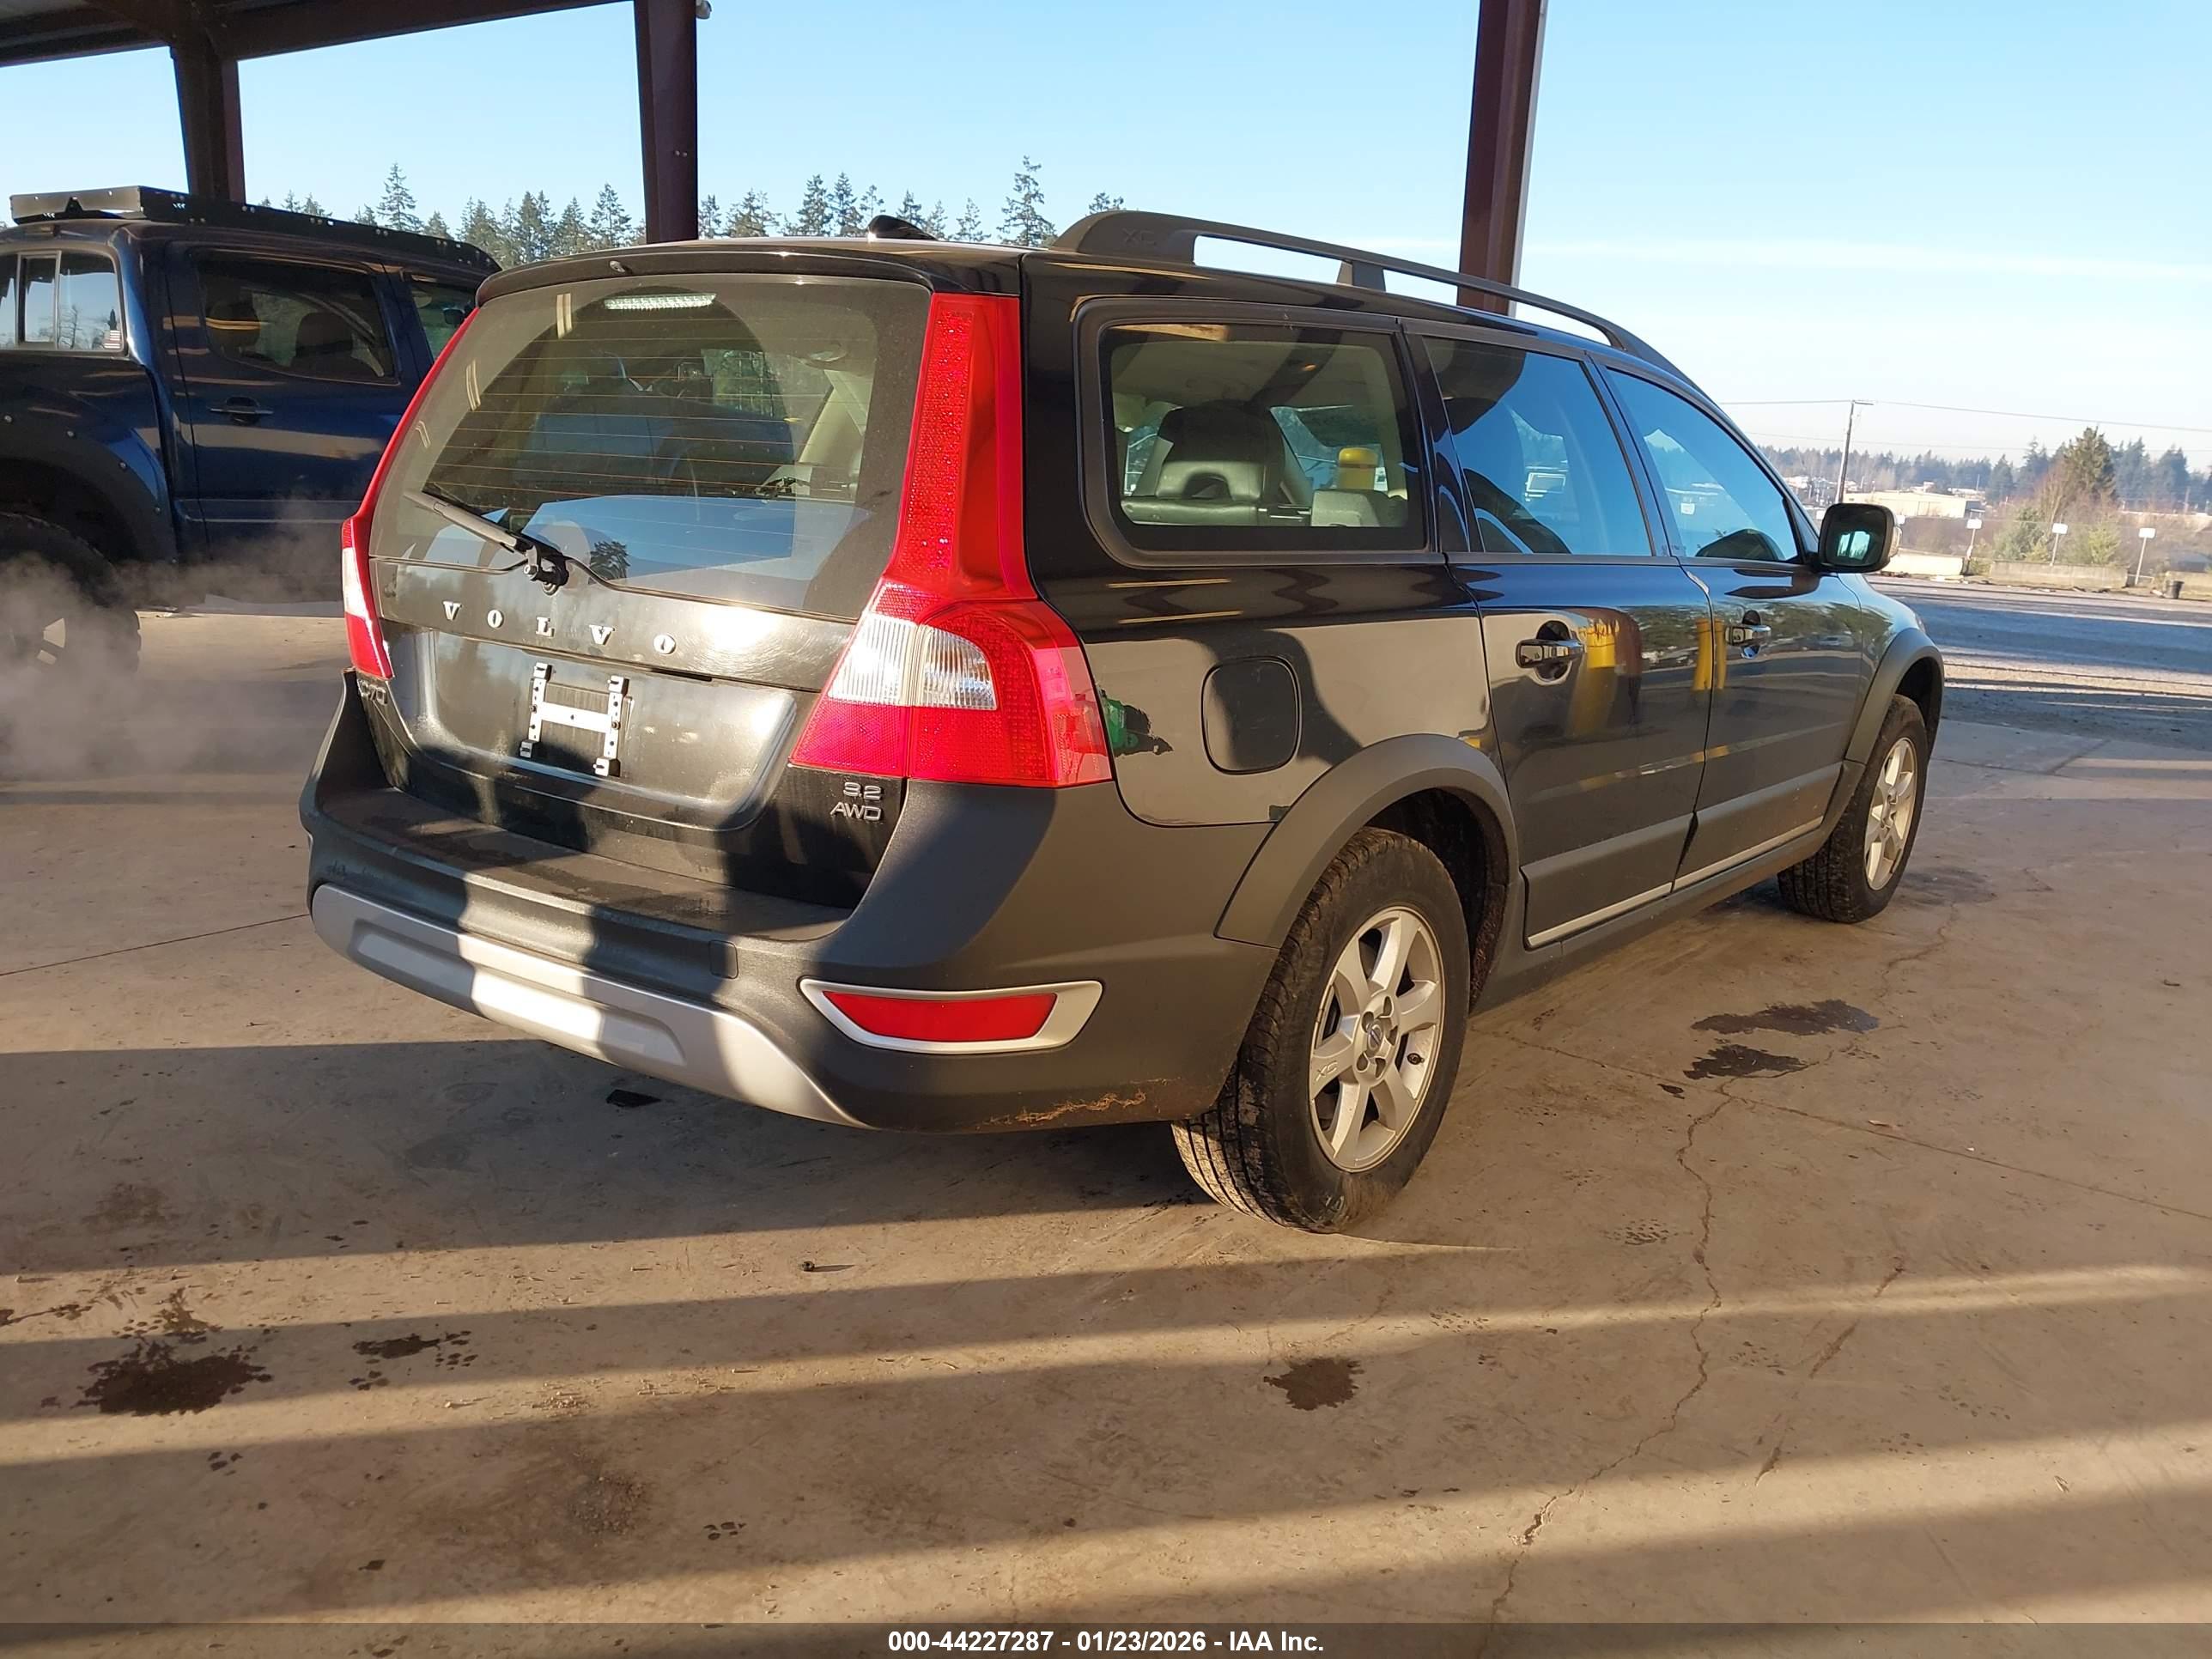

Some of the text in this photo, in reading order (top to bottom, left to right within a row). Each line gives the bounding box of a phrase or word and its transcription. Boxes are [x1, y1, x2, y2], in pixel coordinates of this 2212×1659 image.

[443, 601, 677, 654] VOLVO
[843, 781, 882, 799] 3.2
[830, 802, 882, 820] AWD
